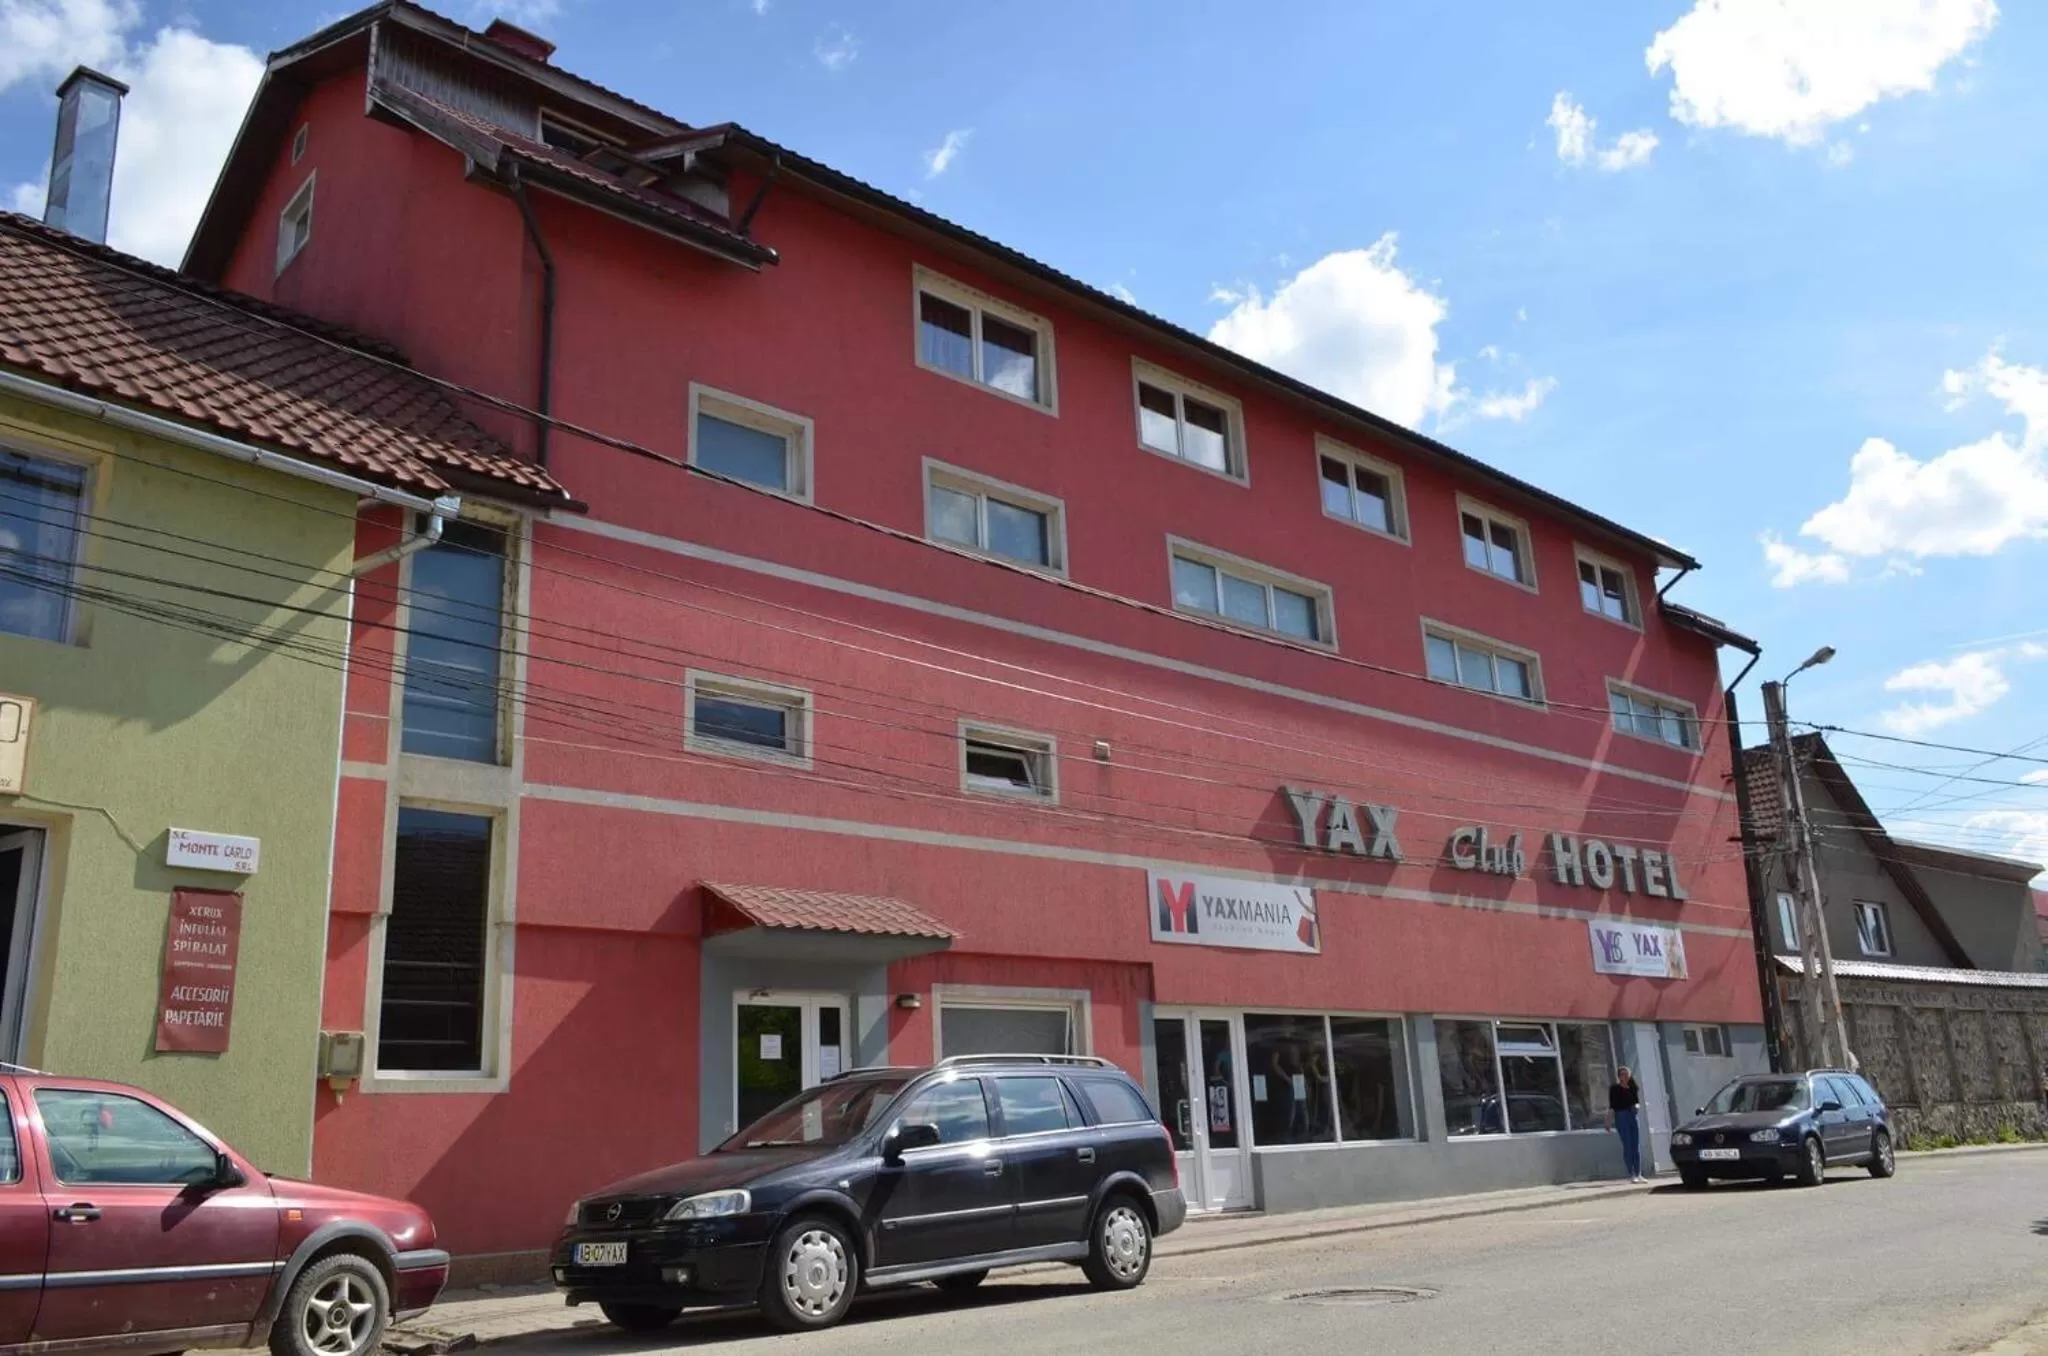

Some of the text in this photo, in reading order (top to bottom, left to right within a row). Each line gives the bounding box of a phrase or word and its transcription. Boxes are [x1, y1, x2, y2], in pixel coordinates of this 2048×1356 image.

[179, 842, 252, 859] MONTE CARLO
[1279, 785, 1402, 861] YAX
[1551, 831, 1690, 901] HOTEL
[1202, 895, 1292, 925] YAXMANIA
[1632, 932, 1662, 957] YAX
